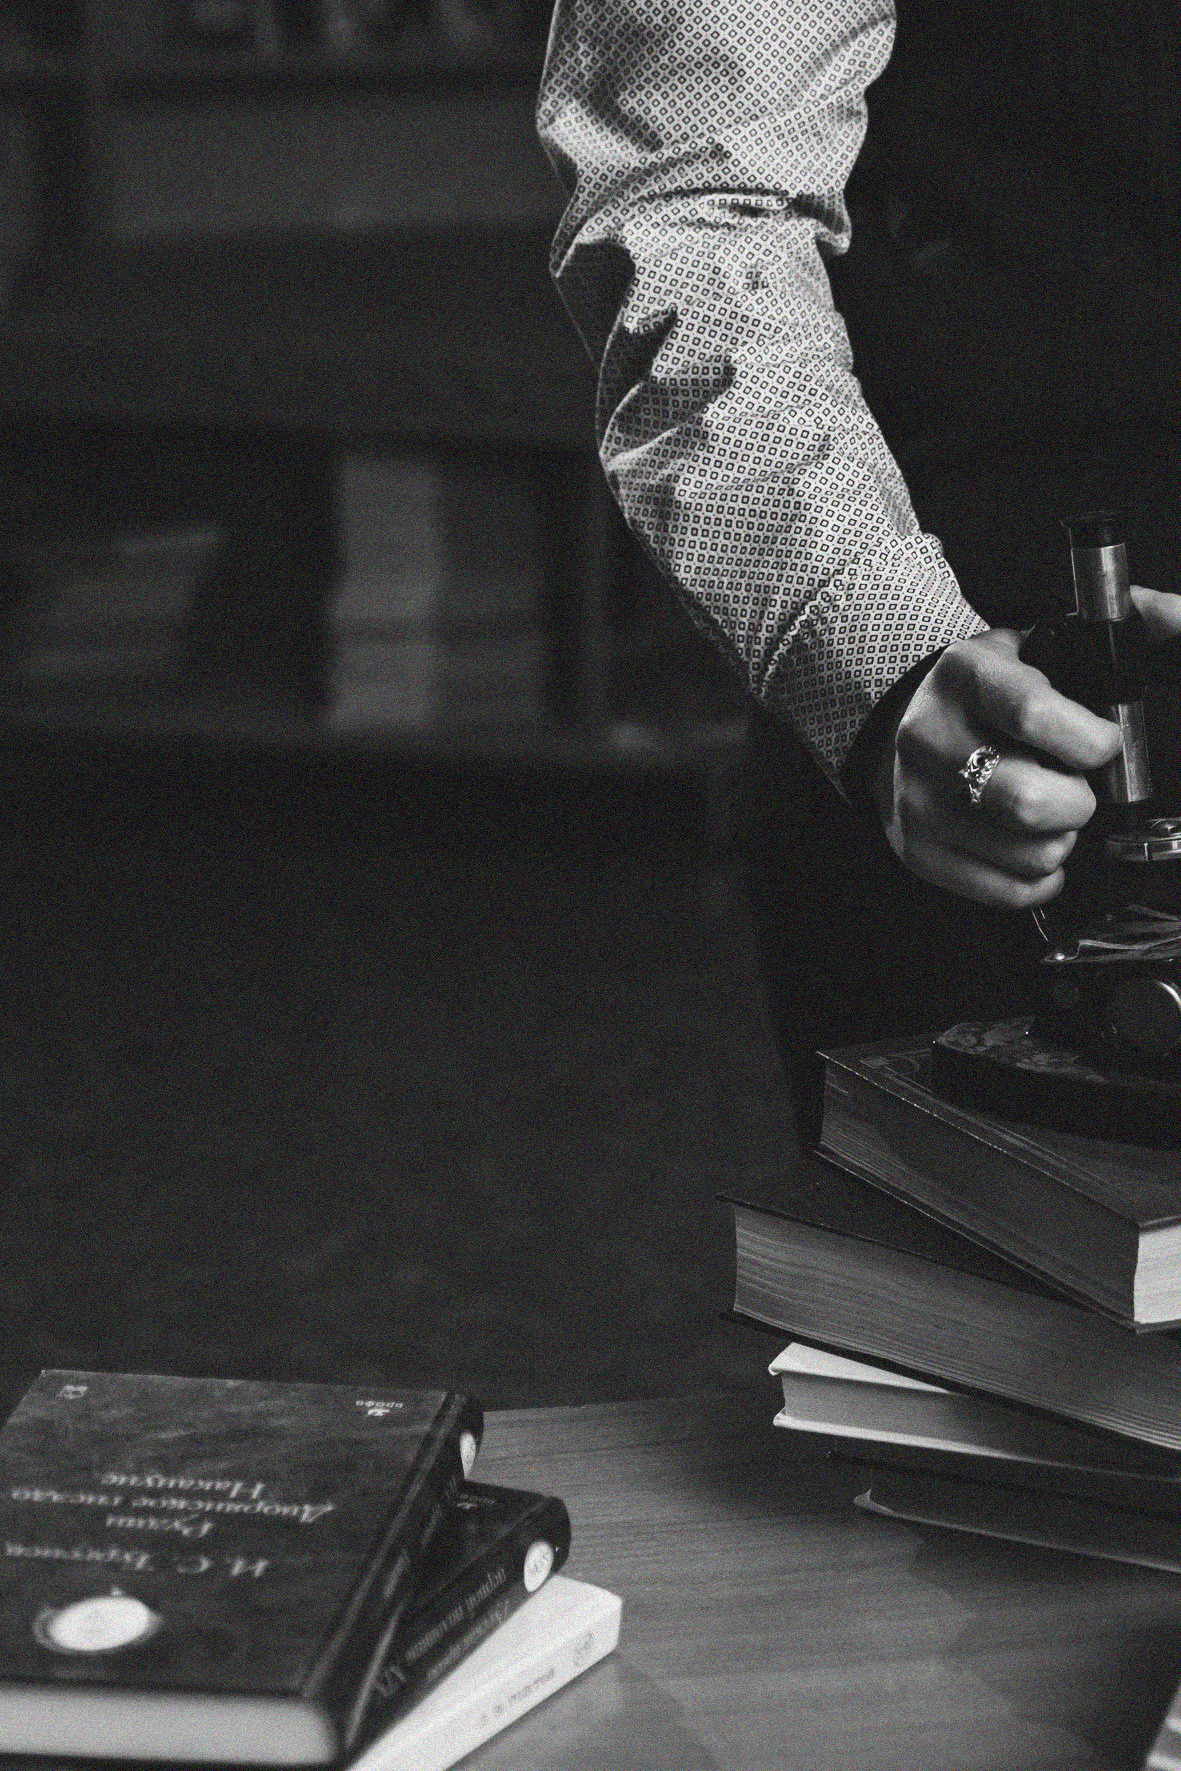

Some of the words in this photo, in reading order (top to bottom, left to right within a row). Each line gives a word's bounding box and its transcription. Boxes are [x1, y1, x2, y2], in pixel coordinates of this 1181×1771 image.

[11, 1487, 123, 1507] гнездо
[100, 1472, 266, 1500] Накануне
[132, 1497, 334, 1523] Дворянское
[105, 1513, 214, 1539] Рудин
[5, 1541, 150, 1571] Тургенев
